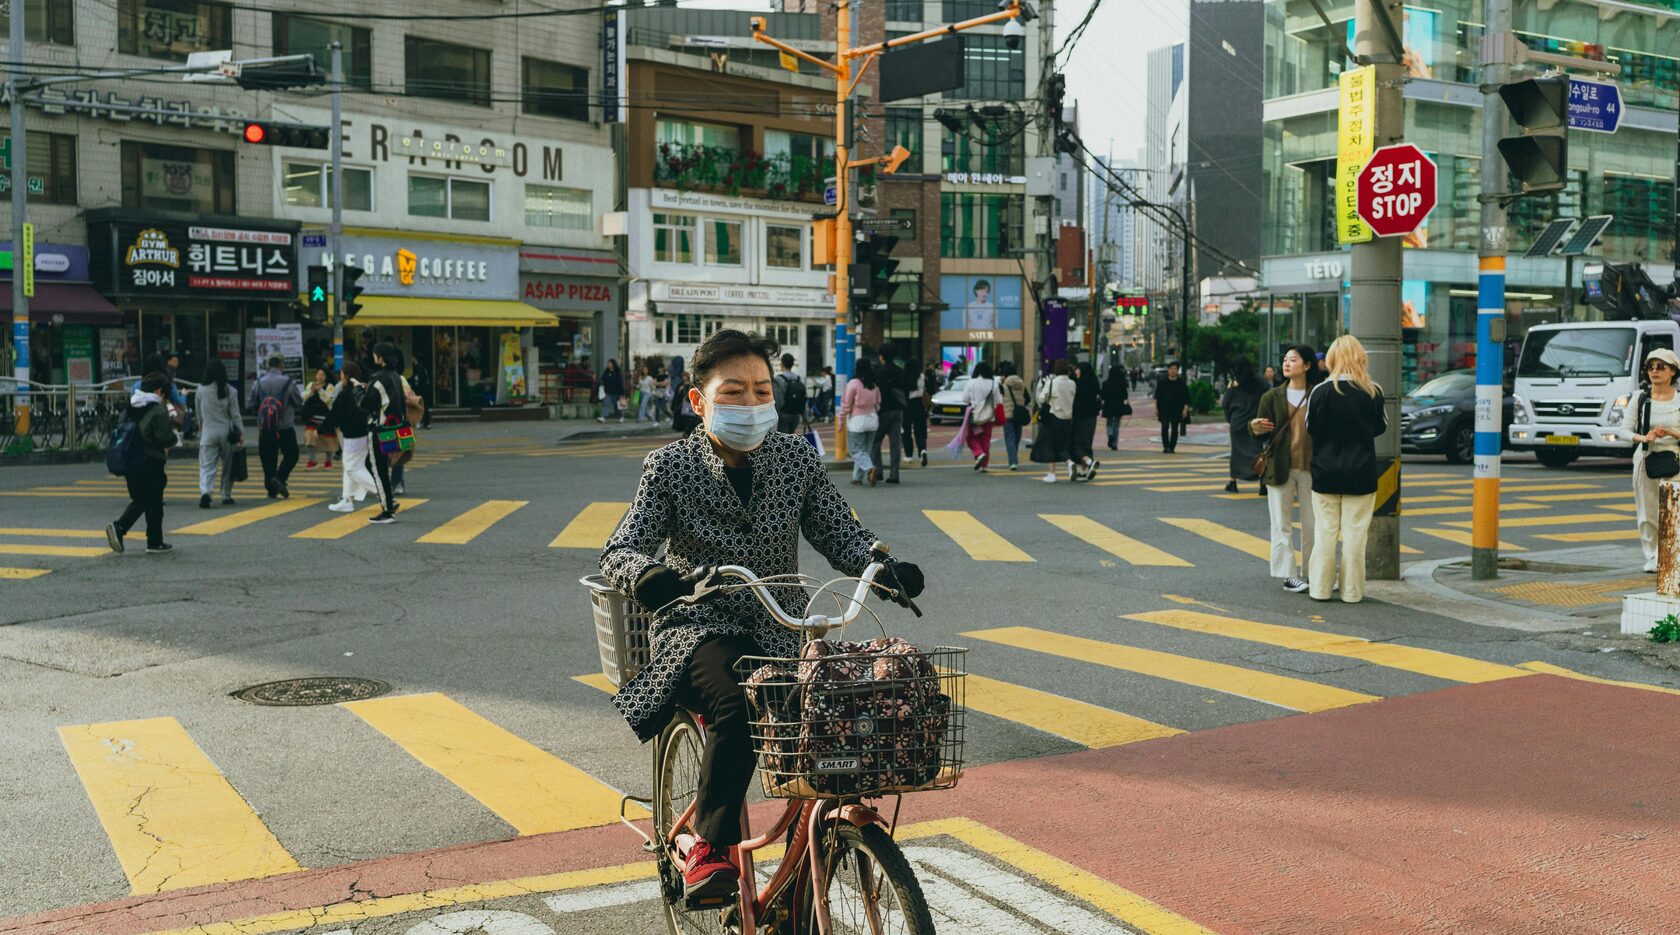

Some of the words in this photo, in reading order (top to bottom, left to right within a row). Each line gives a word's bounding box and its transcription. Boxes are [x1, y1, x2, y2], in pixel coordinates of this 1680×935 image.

[1569, 103, 1600, 115] ongsuil-ro
[1606, 102, 1616, 114] 44
[1370, 160, 1422, 194] 정지
[1372, 192, 1422, 219] STOP
[142, 239, 166, 249] GYM
[131, 248, 177, 264] ARTHUR
[187, 243, 289, 275] 휘트니스
[420, 257, 487, 280] COFFEE
[133, 269, 175, 287] 짐아서
[568, 284, 612, 302] PIZZA
[821, 760, 855, 769] SMART
